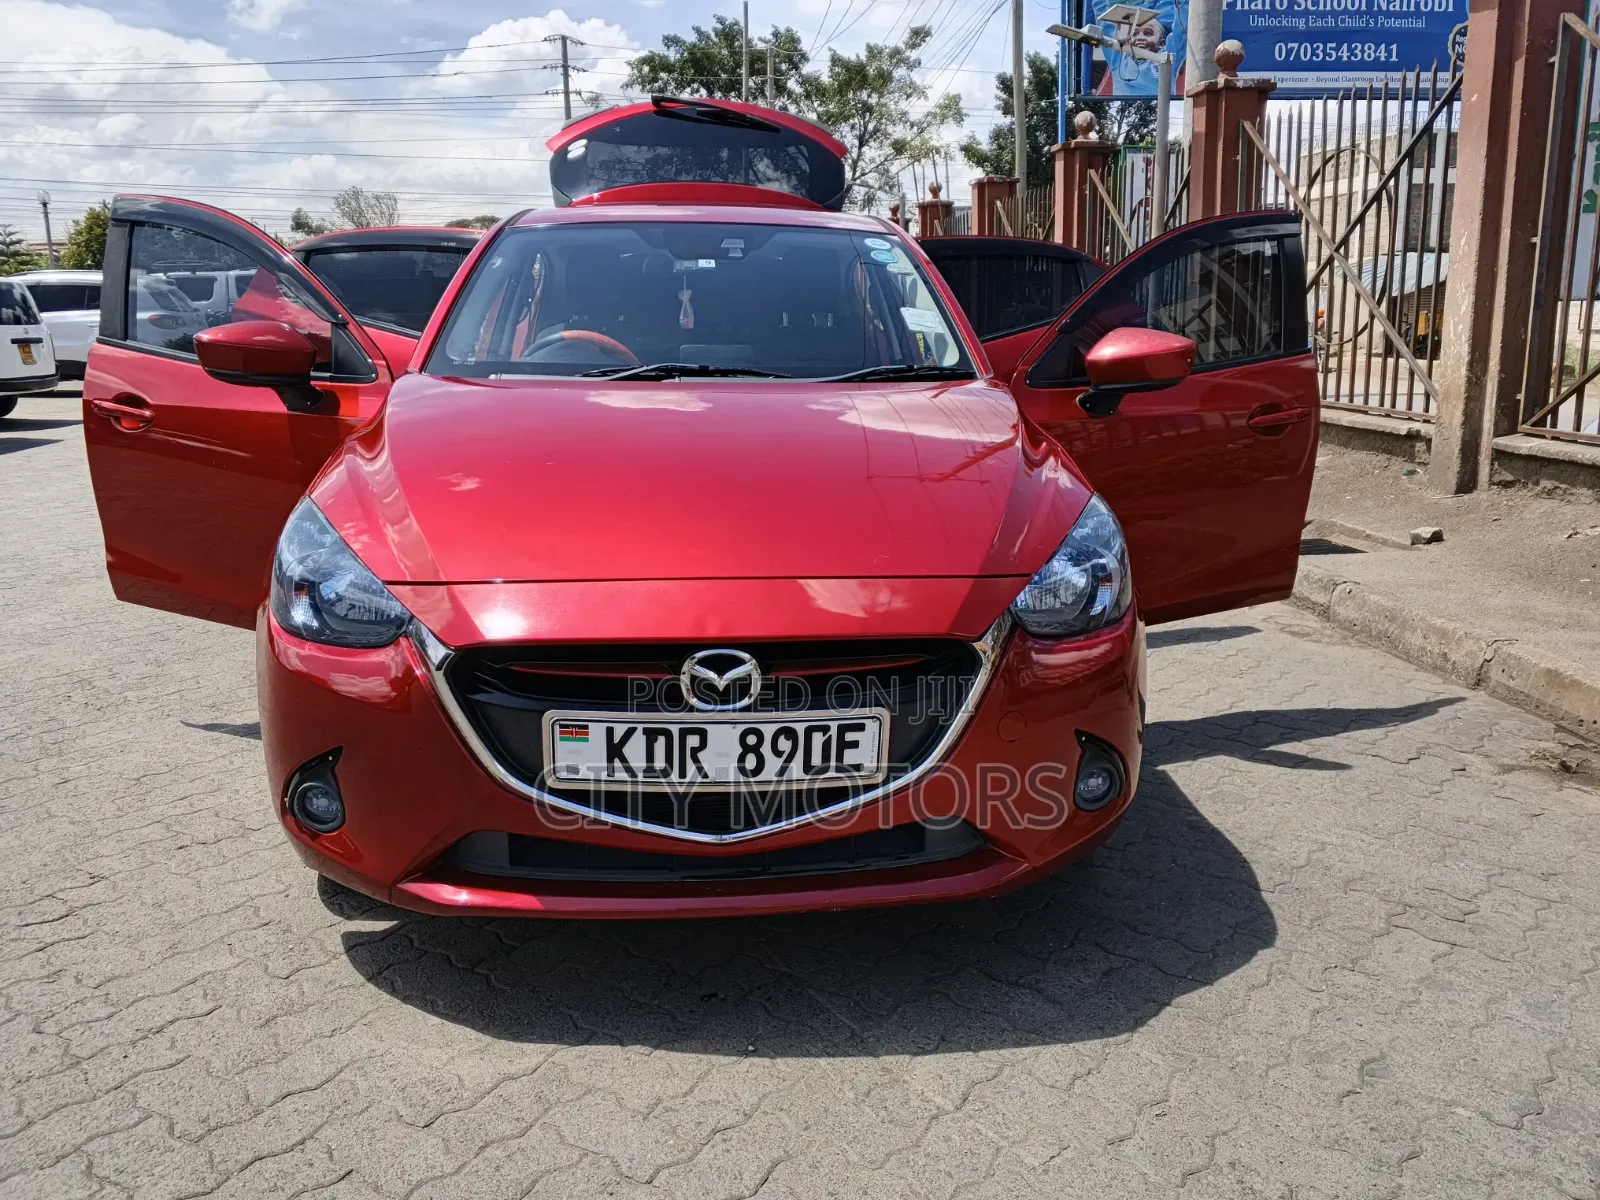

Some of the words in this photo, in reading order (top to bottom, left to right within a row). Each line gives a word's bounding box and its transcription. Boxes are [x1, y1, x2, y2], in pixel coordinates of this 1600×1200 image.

[1293, 0, 1367, 11] School
[1373, 0, 1455, 11] Nairobi
[1249, 14, 1306, 29] Unlocking
[1309, 15, 1335, 27] Each
[1338, 15, 1375, 27] Child's
[1377, 15, 1426, 28] Potential
[1274, 42, 1399, 61] 0703543841
[1316, 75, 1340, 83] Beyond
[1342, 75, 1375, 83] Classroom
[605, 725, 710, 780] KDR
[736, 722, 866, 779] 890E
